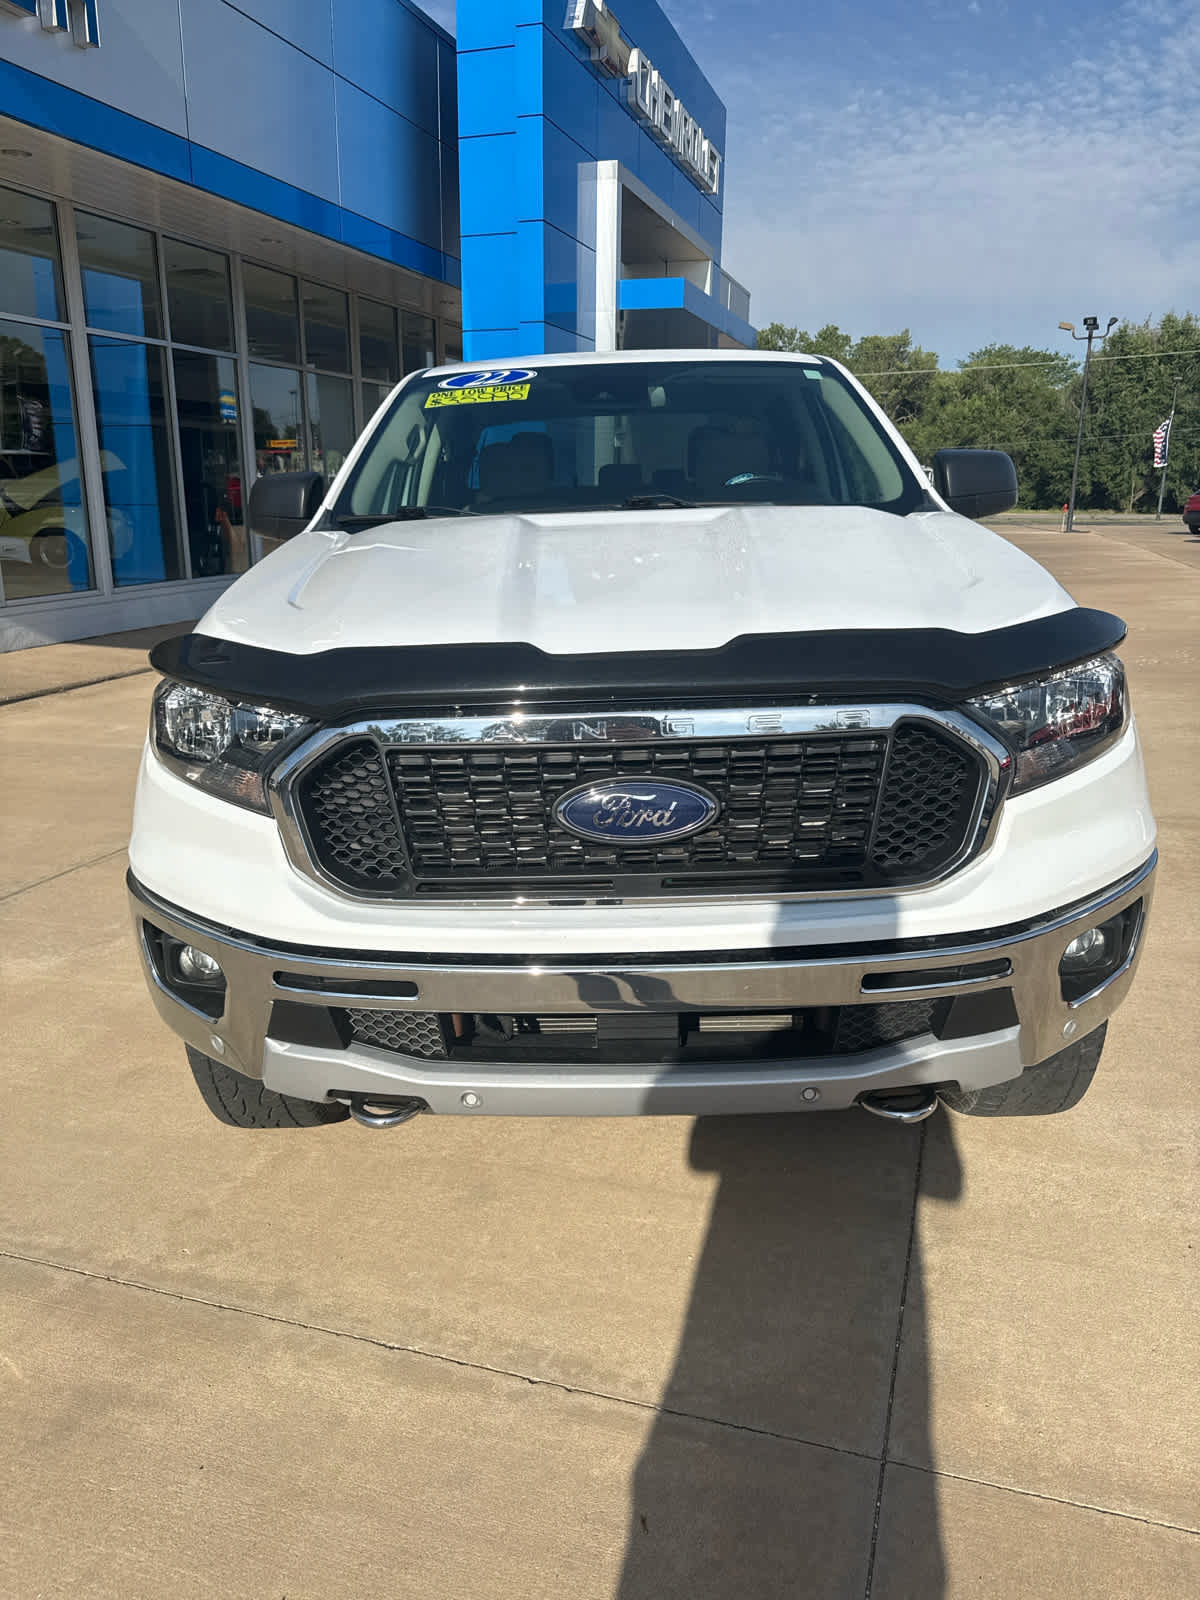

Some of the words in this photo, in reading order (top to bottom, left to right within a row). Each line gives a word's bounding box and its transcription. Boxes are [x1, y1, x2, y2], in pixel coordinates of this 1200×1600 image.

[431, 391, 457, 399] ONE
[493, 384, 526, 393] PRICE
[463, 370, 511, 387] 22
[399, 708, 872, 743] RANGER
[592, 793, 678, 828] Ford
